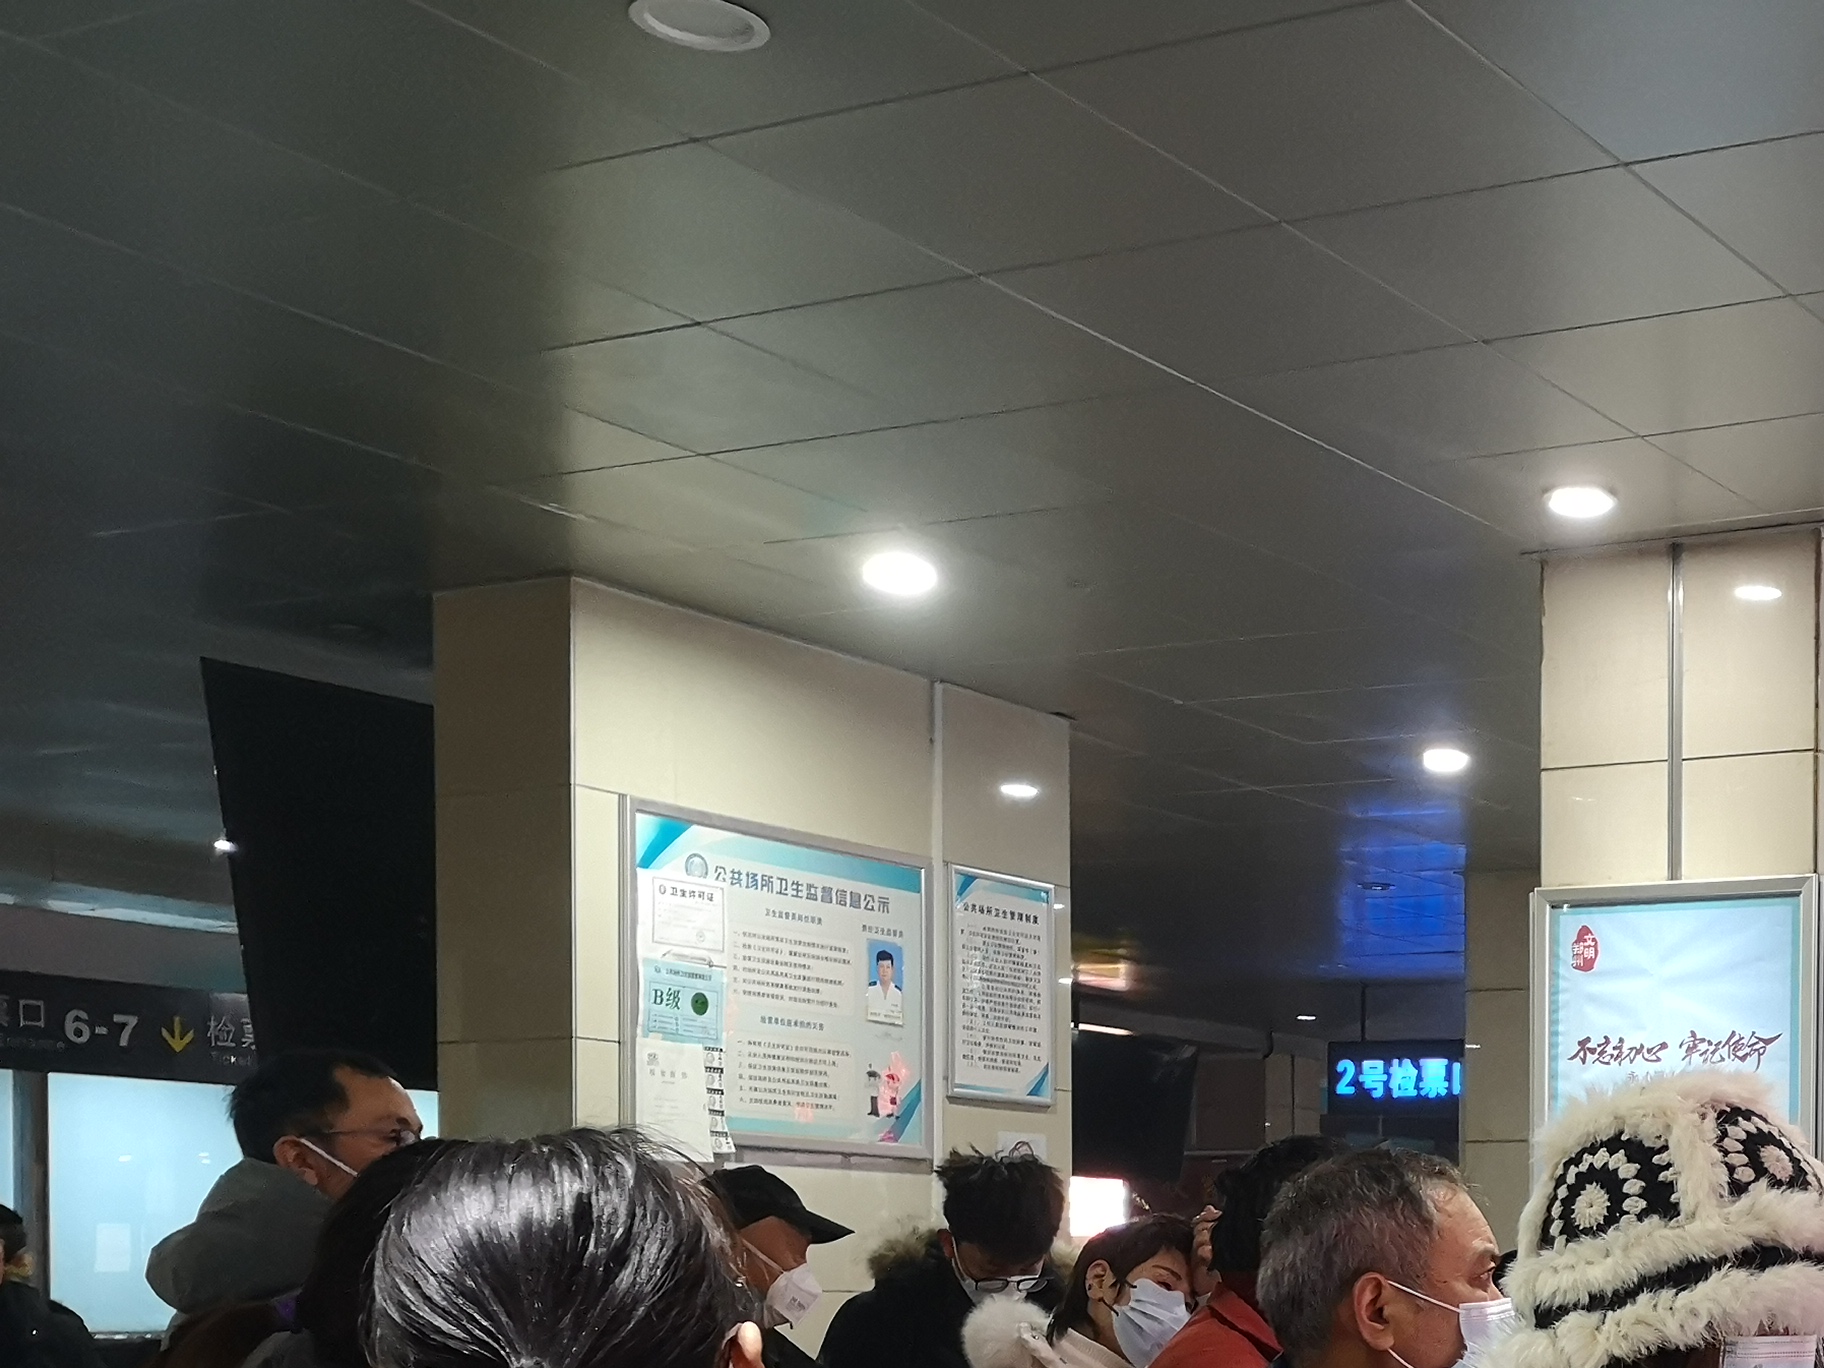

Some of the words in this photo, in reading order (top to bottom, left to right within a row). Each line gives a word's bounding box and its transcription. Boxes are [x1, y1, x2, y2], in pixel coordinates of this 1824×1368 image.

[669, 886, 715, 903] 卫生许可证
[714, 865, 891, 915] 公共场所卫生监督信息公示
[962, 901, 1040, 925] 公共场所卫生管理制度
[652, 987, 681, 1011] B级
[64, 1009, 138, 1047] 6-7
[1567, 1034, 1669, 1067] 不忘初心
[1678, 1029, 1783, 1073] 牢记使命
